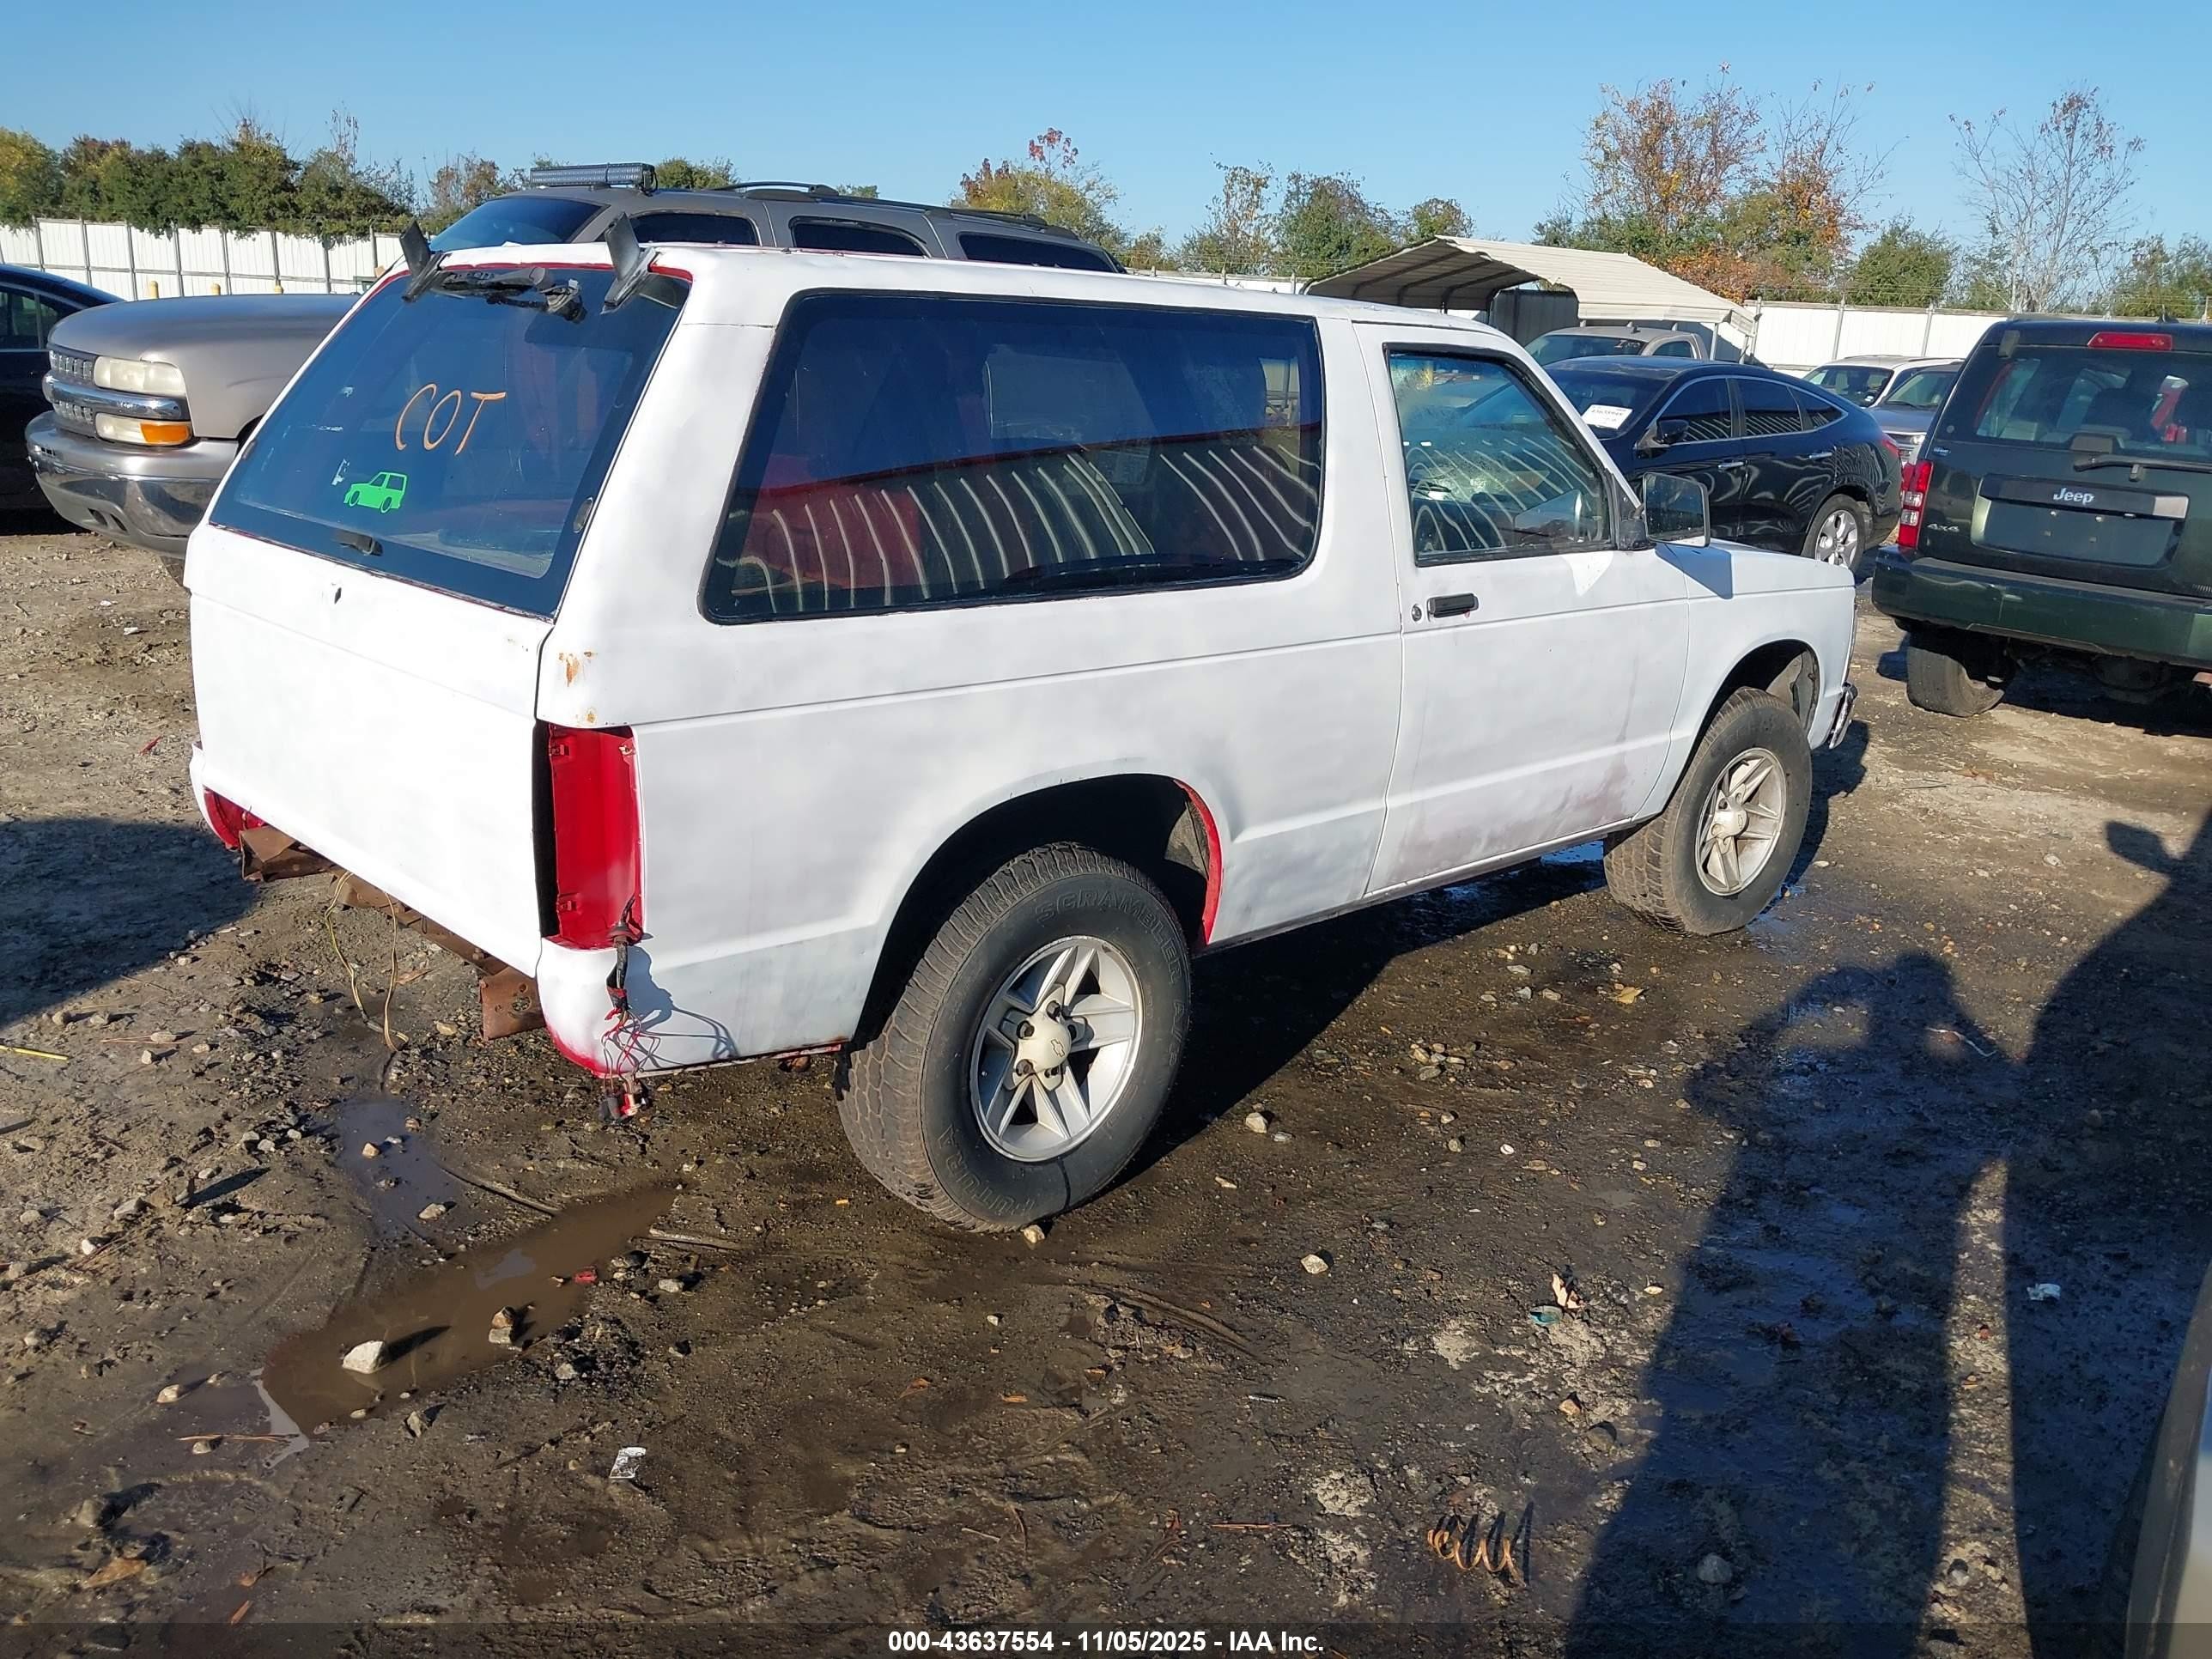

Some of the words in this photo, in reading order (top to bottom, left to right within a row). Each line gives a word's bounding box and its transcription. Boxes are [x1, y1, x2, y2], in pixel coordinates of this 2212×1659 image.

[395, 383, 506, 455] COT
[2052, 487, 2095, 505] Jeep
[1034, 888, 1184, 985] SCRAMBLER
